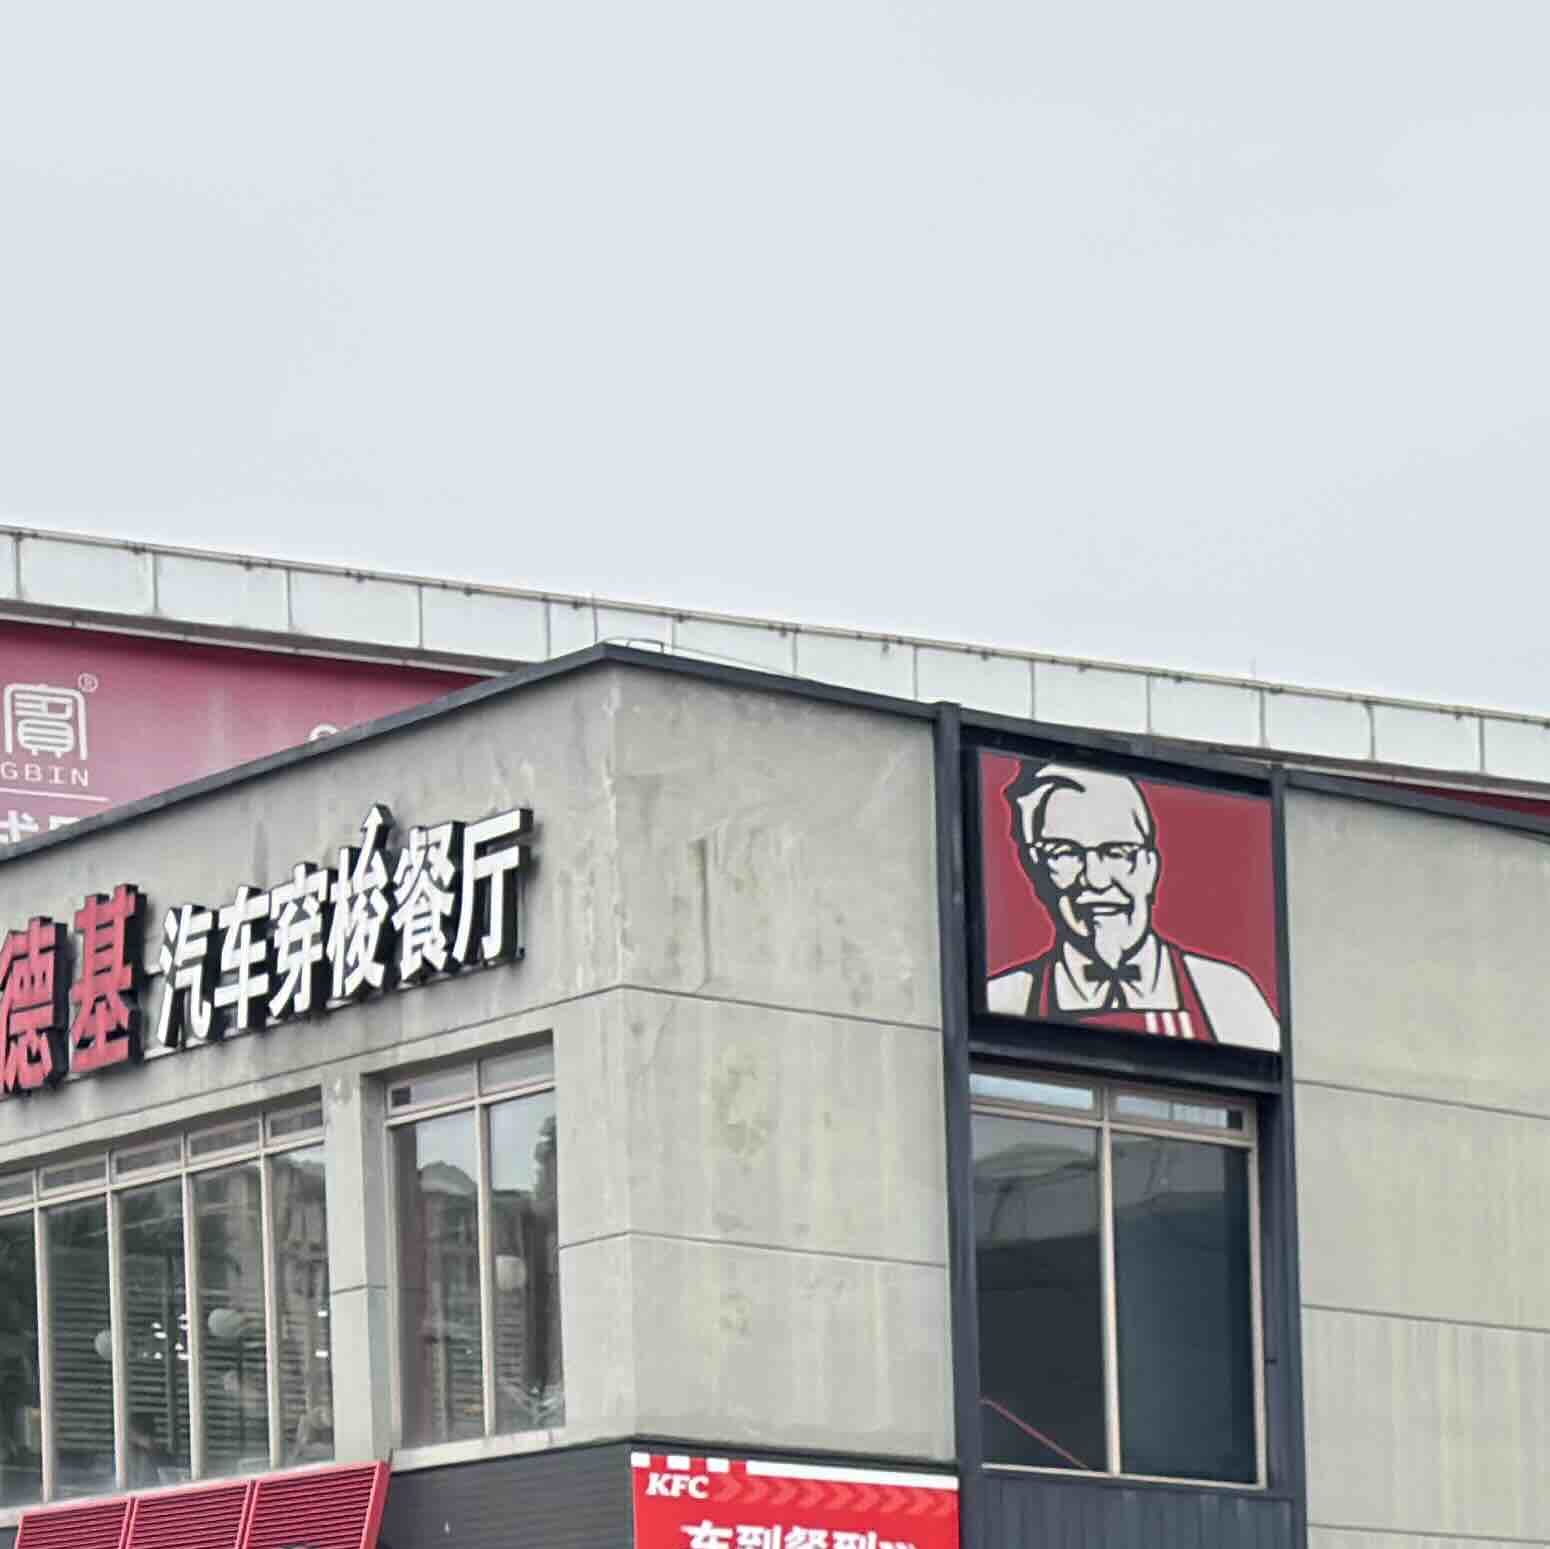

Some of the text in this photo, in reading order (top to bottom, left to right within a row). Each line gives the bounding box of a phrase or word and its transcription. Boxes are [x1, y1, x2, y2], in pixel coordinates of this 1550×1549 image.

[158, 804, 522, 1046] 汽车穿梭餐厅
[647, 1472, 710, 1500] KFC
